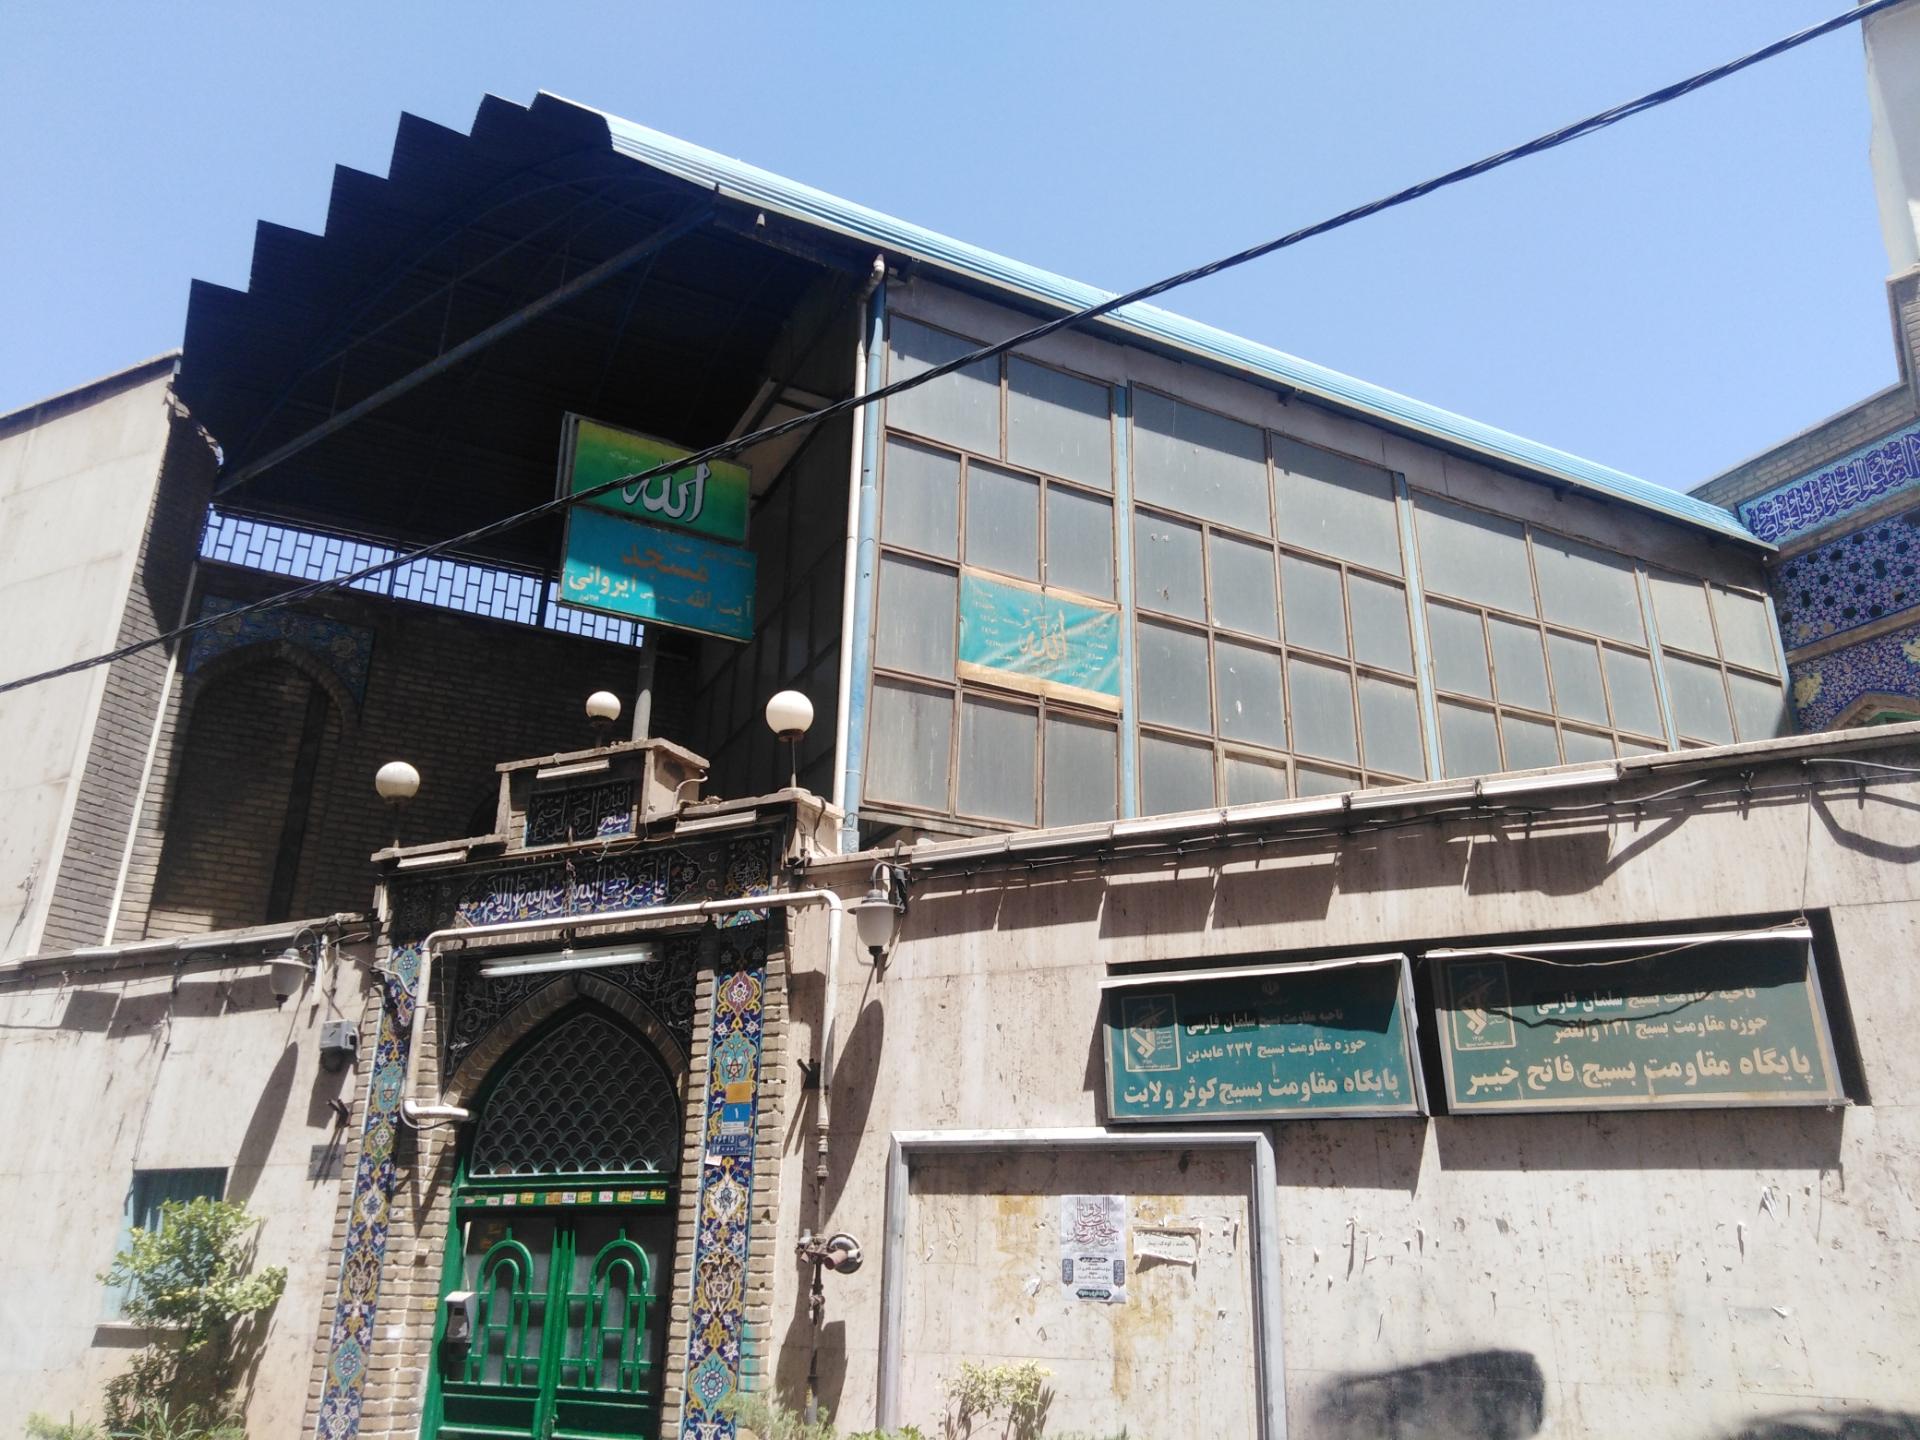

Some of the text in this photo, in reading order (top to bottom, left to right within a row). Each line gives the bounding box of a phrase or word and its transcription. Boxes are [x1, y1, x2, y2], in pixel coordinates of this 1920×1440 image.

[622, 460, 711, 522] الله
[623, 544, 709, 582] مسجد
[569, 565, 637, 600] ایروانی
[1536, 992, 1577, 1015] فارسی
[1583, 990, 1623, 1012] سلمان
[1629, 995, 1660, 1009] بسیج
[1720, 987, 1756, 1002] ناحیه
[1186, 1014, 1220, 1035] فارسی
[1223, 1012, 1256, 1033] سلمان
[1258, 1015, 1281, 1028] بسیج
[1319, 1009, 1344, 1021] ناحیه
[1635, 1021, 1669, 1040] بسیج
[1673, 1014, 1726, 1037] مقاومت
[1730, 1016, 1768, 1036] حوزه
[1186, 1045, 1224, 1063] عابدین
[1257, 1043, 1286, 1059] بسیج
[1287, 1038, 1332, 1056] مقاومت
[1334, 1039, 1367, 1055] حوزه
[1466, 1047, 1814, 1095] پایگاه مقاومت بسیج فاتح خیبر
[1123, 1068, 1400, 1109] پایگاه مقاومت بسیج کوثر ولایت
